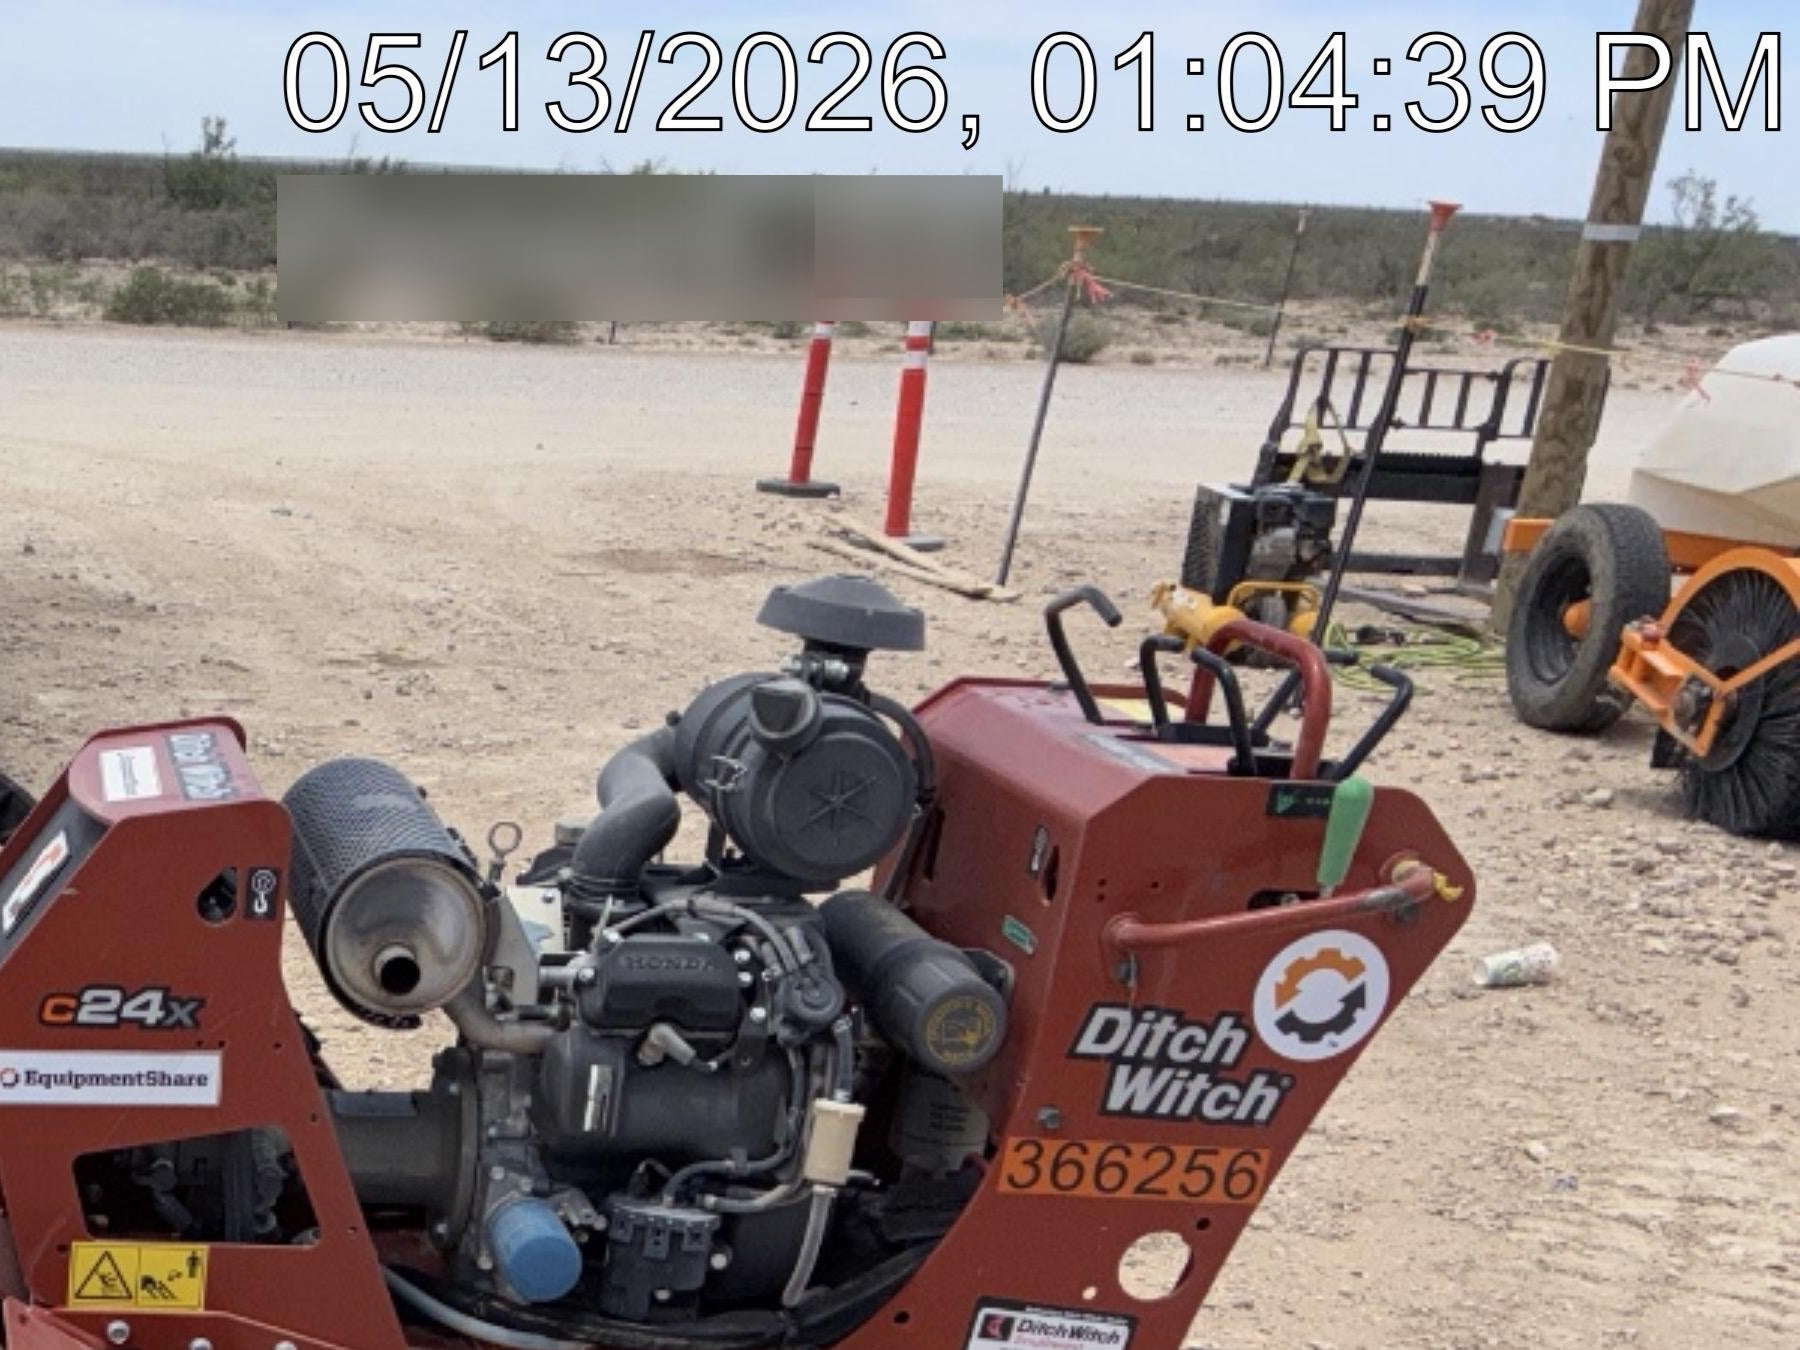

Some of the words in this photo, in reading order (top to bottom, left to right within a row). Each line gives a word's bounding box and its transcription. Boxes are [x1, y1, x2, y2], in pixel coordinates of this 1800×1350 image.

[1073, 1007, 1249, 1065] Ditch
[24, 1069, 208, 1089] EquipmentShare
[1106, 1064, 1285, 1121] Witch
[1006, 1139, 1262, 1200] 366256
